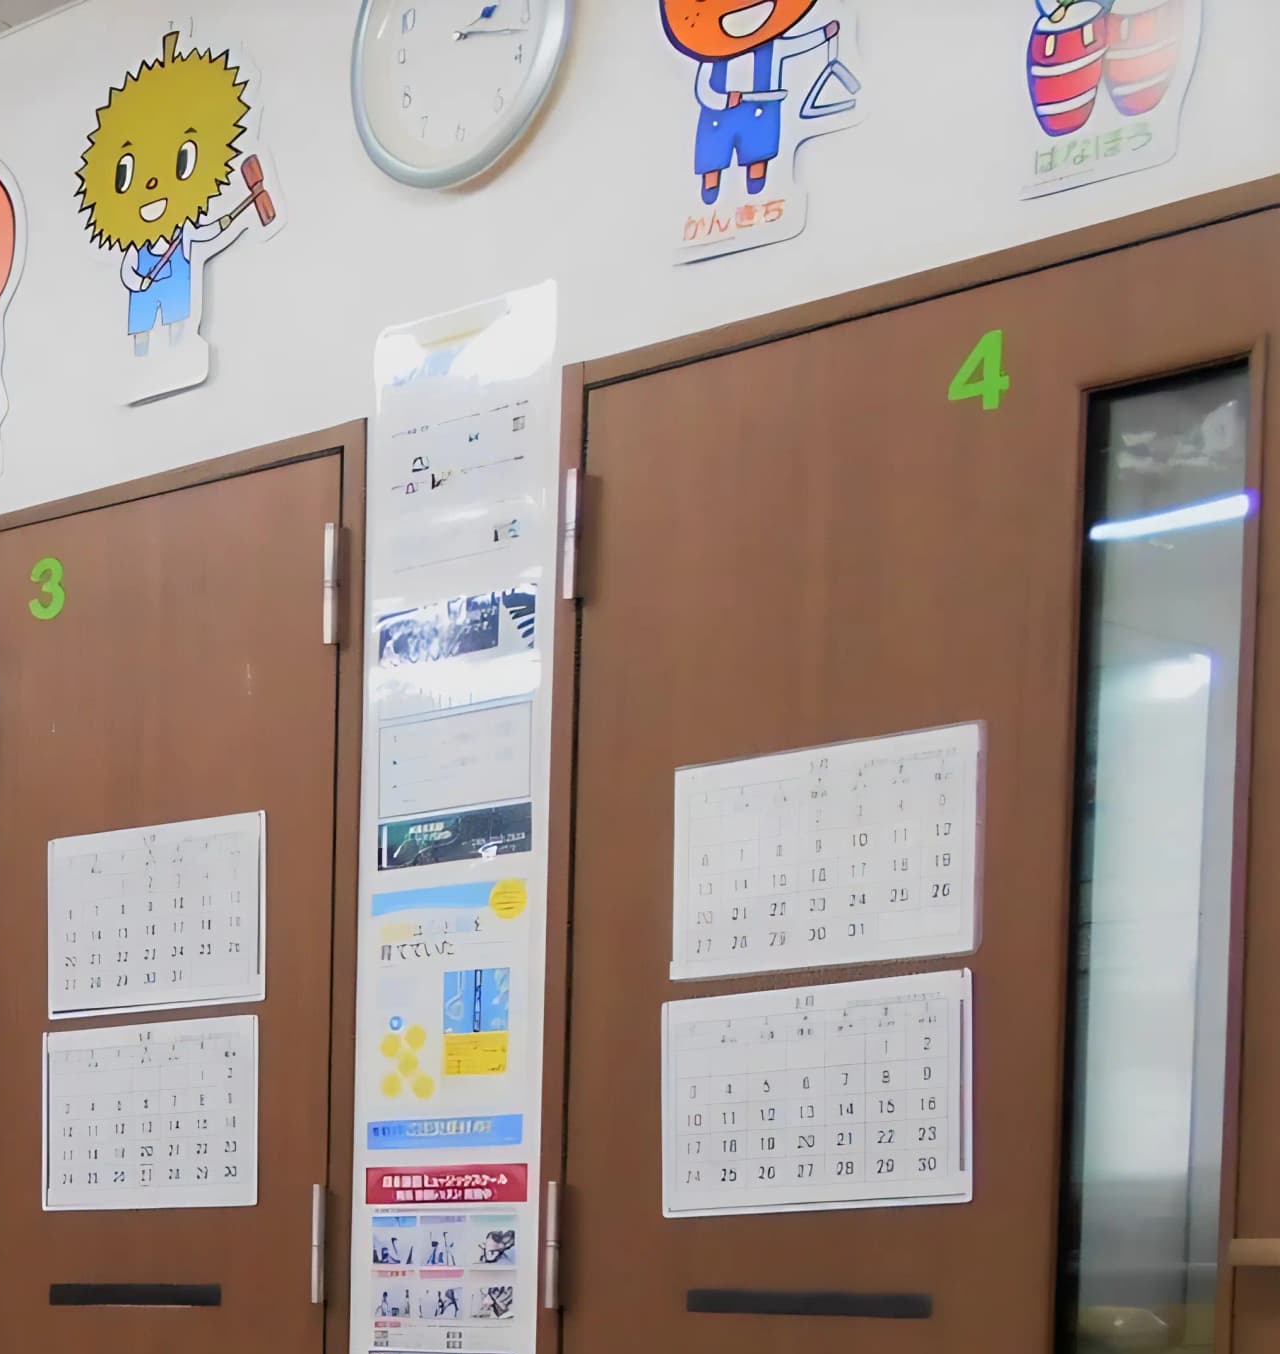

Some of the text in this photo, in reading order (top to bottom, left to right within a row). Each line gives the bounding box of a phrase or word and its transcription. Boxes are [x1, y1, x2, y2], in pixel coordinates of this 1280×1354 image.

[947, 329, 1010, 411] 4
[28, 556, 65, 621] 3
[917, 1156, 938, 1172] 30
